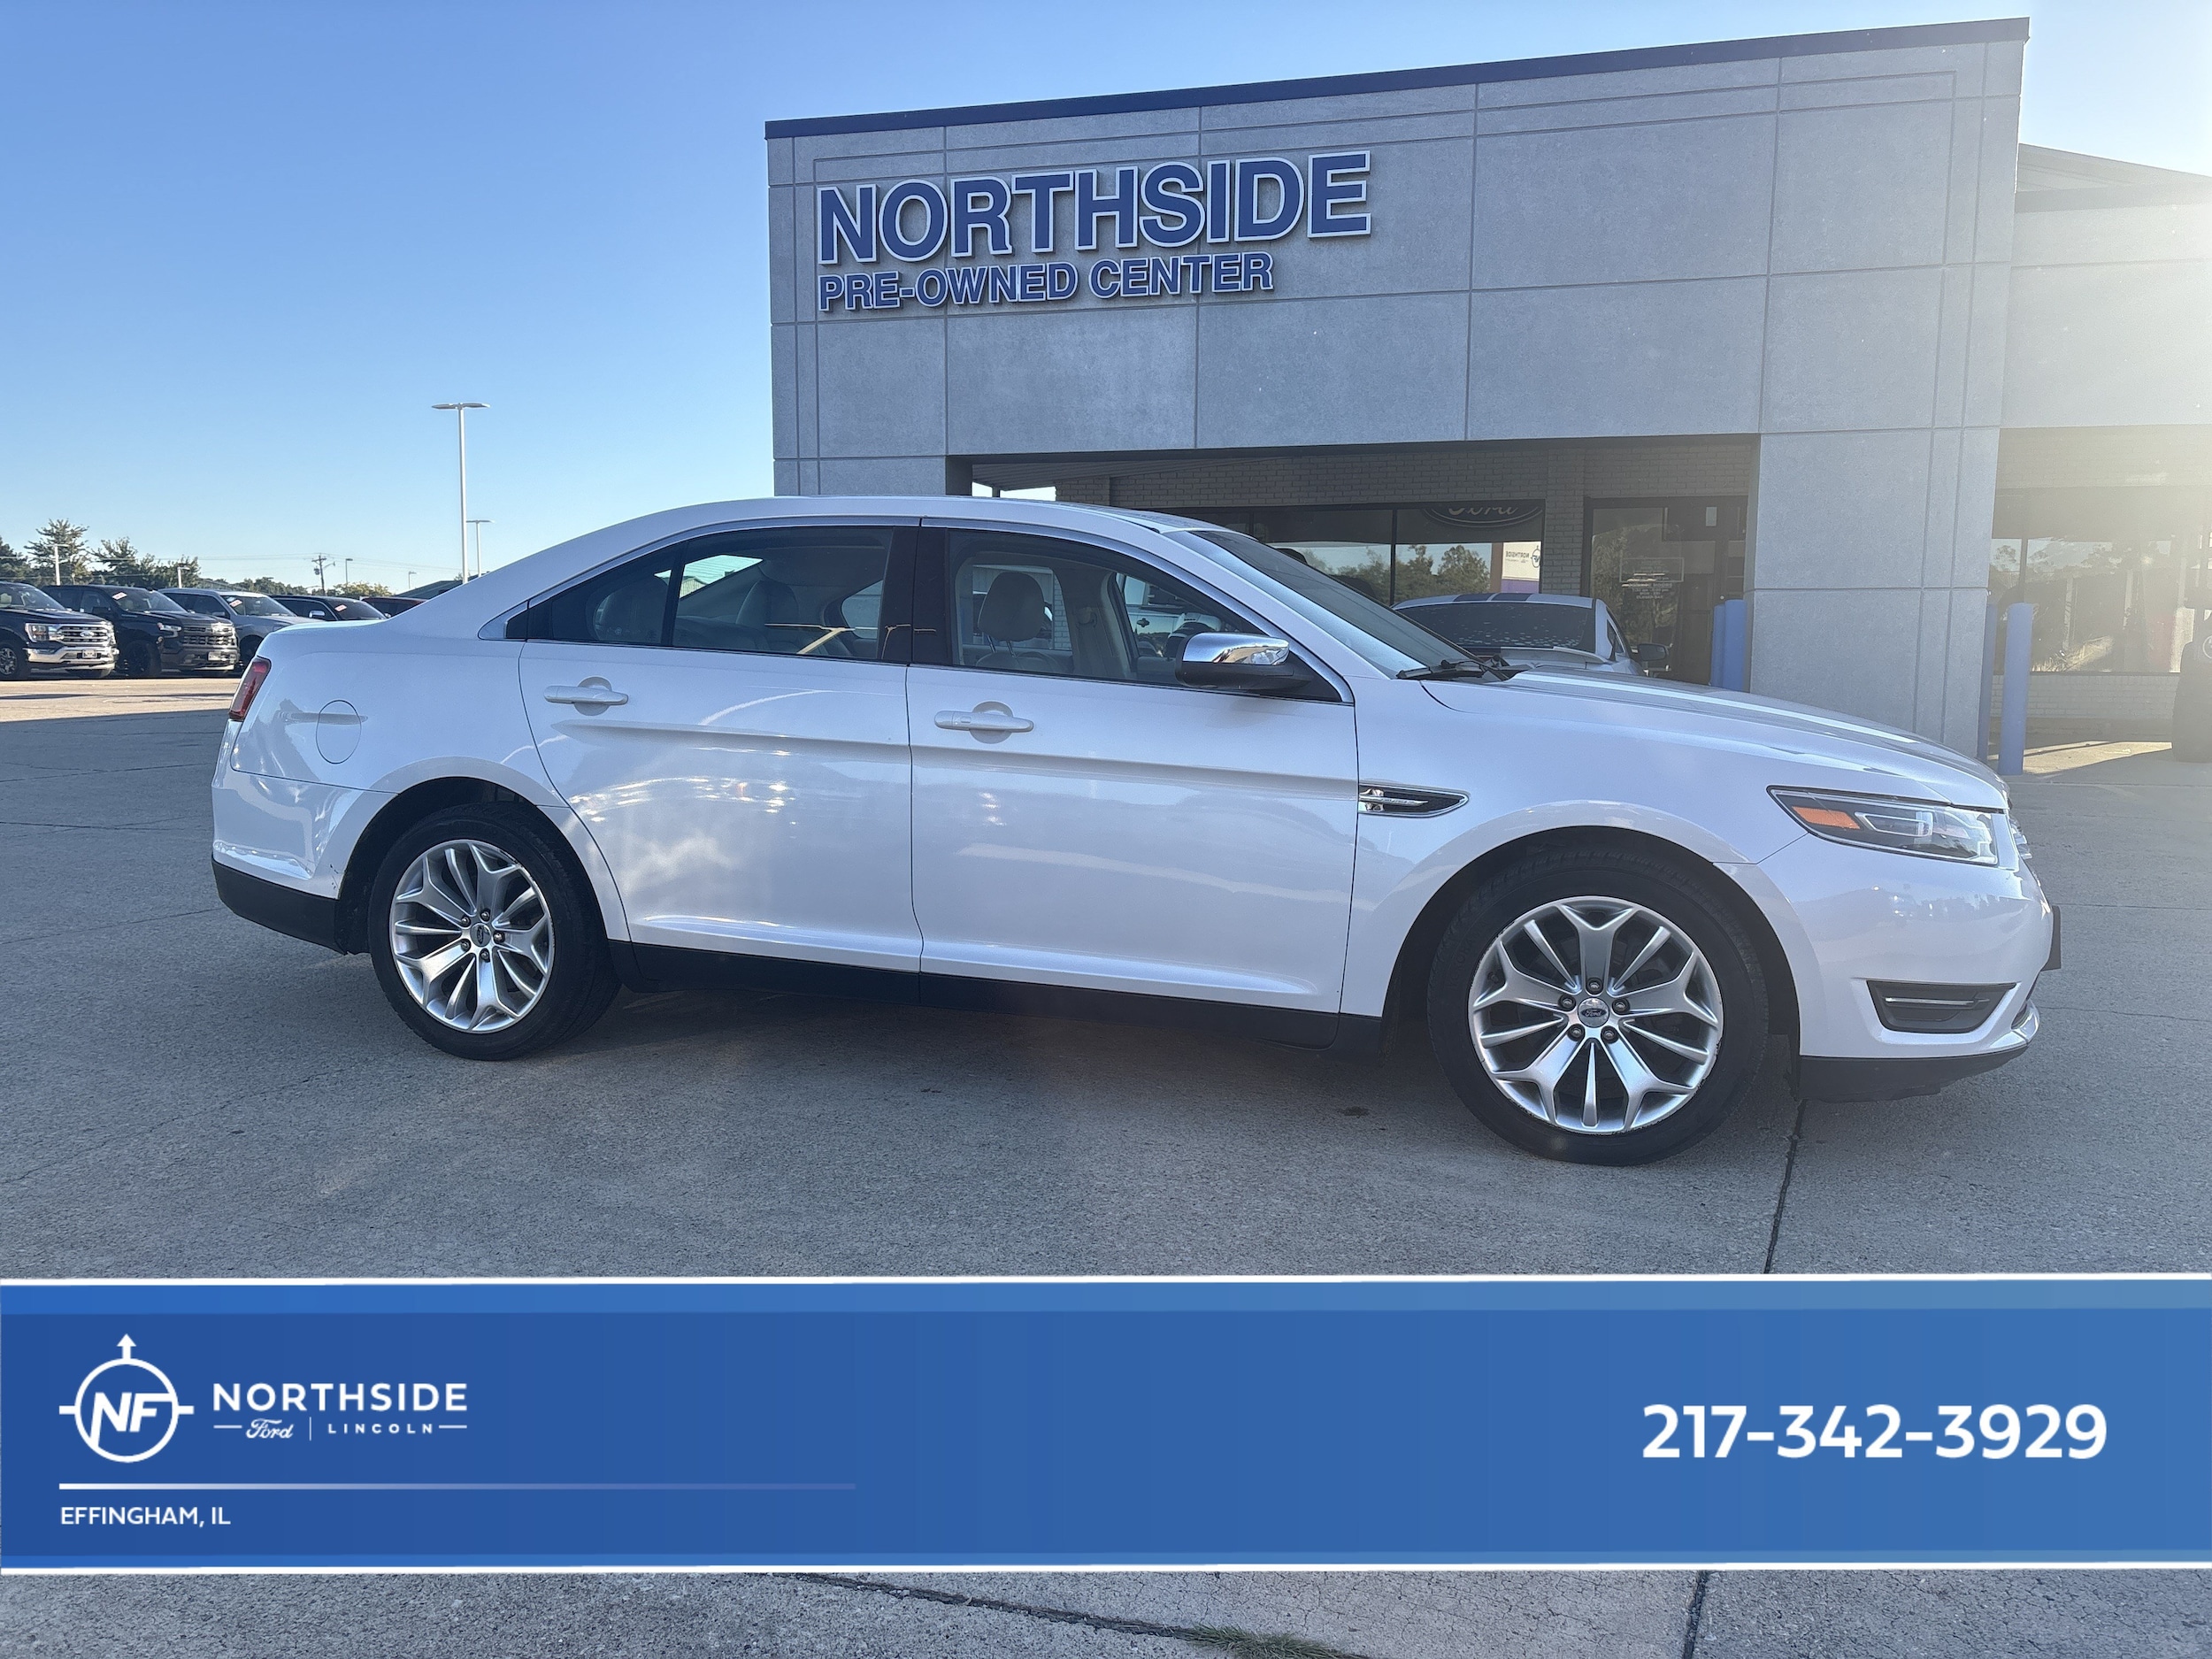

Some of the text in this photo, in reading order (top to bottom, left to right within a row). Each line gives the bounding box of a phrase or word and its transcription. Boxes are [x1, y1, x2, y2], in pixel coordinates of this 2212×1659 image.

[817, 150, 1371, 265] NORTHSIDE
[818, 250, 1274, 312] PRE-OWNED CENTER
